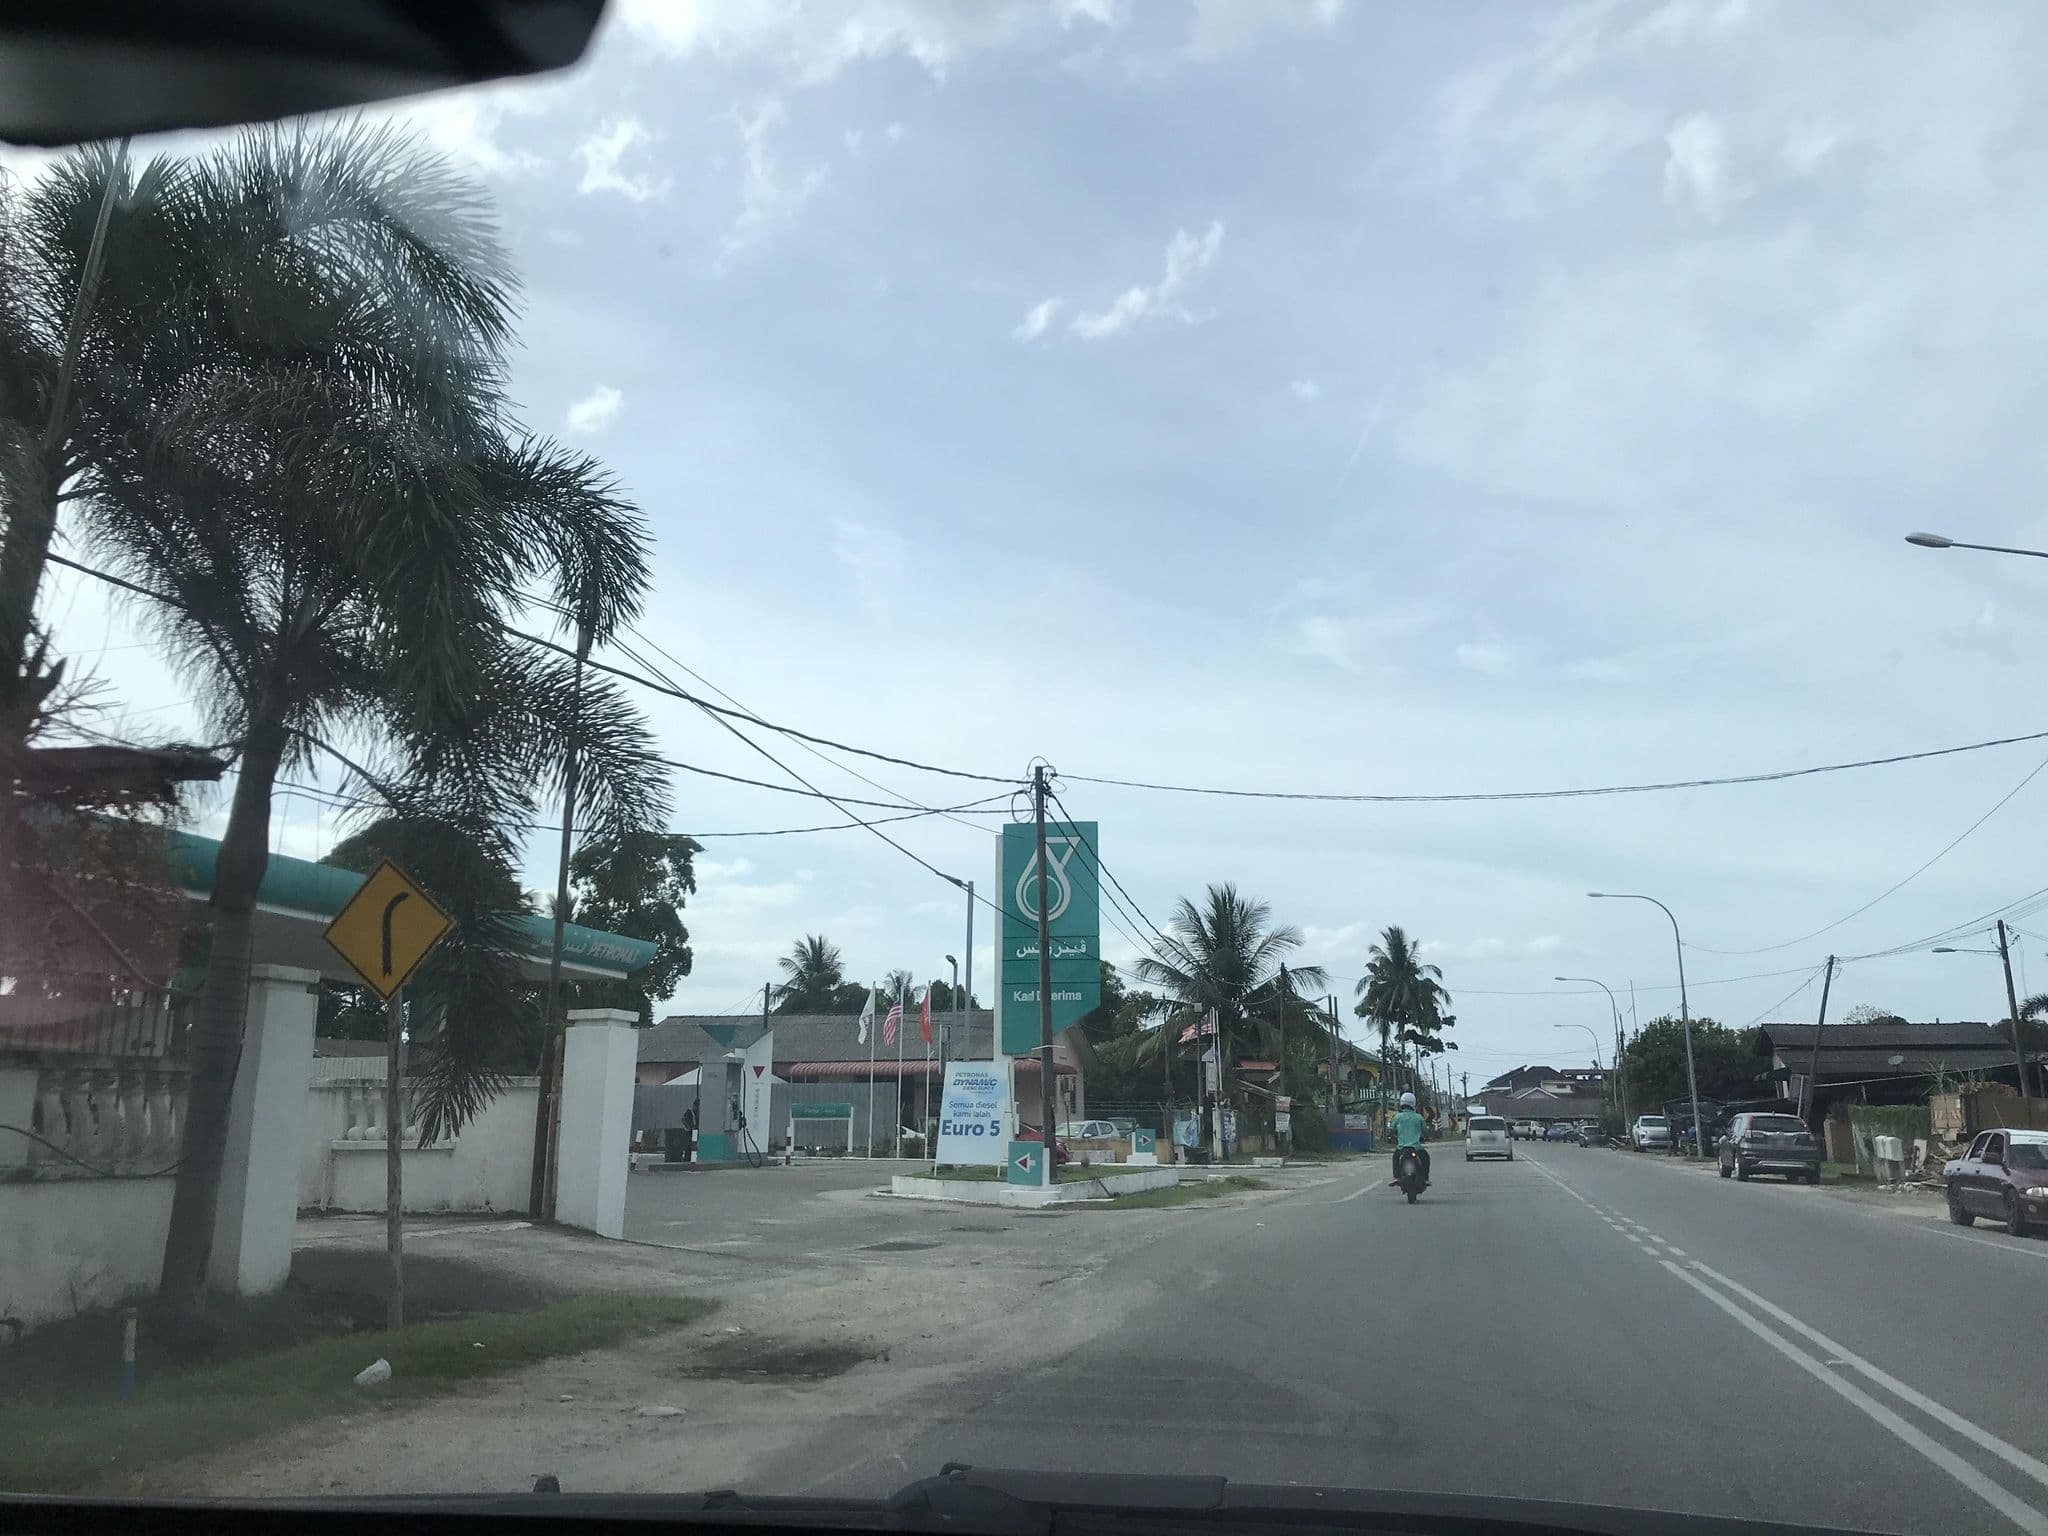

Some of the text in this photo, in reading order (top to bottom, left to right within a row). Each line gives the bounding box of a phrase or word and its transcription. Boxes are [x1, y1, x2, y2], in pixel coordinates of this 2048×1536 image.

[1013, 990, 1082, 1001] Kad erima
[953, 1078, 998, 1086] DYNAMIC
[949, 1101, 997, 1109] Semua diesel
[941, 1119, 1000, 1136] Euro 5
